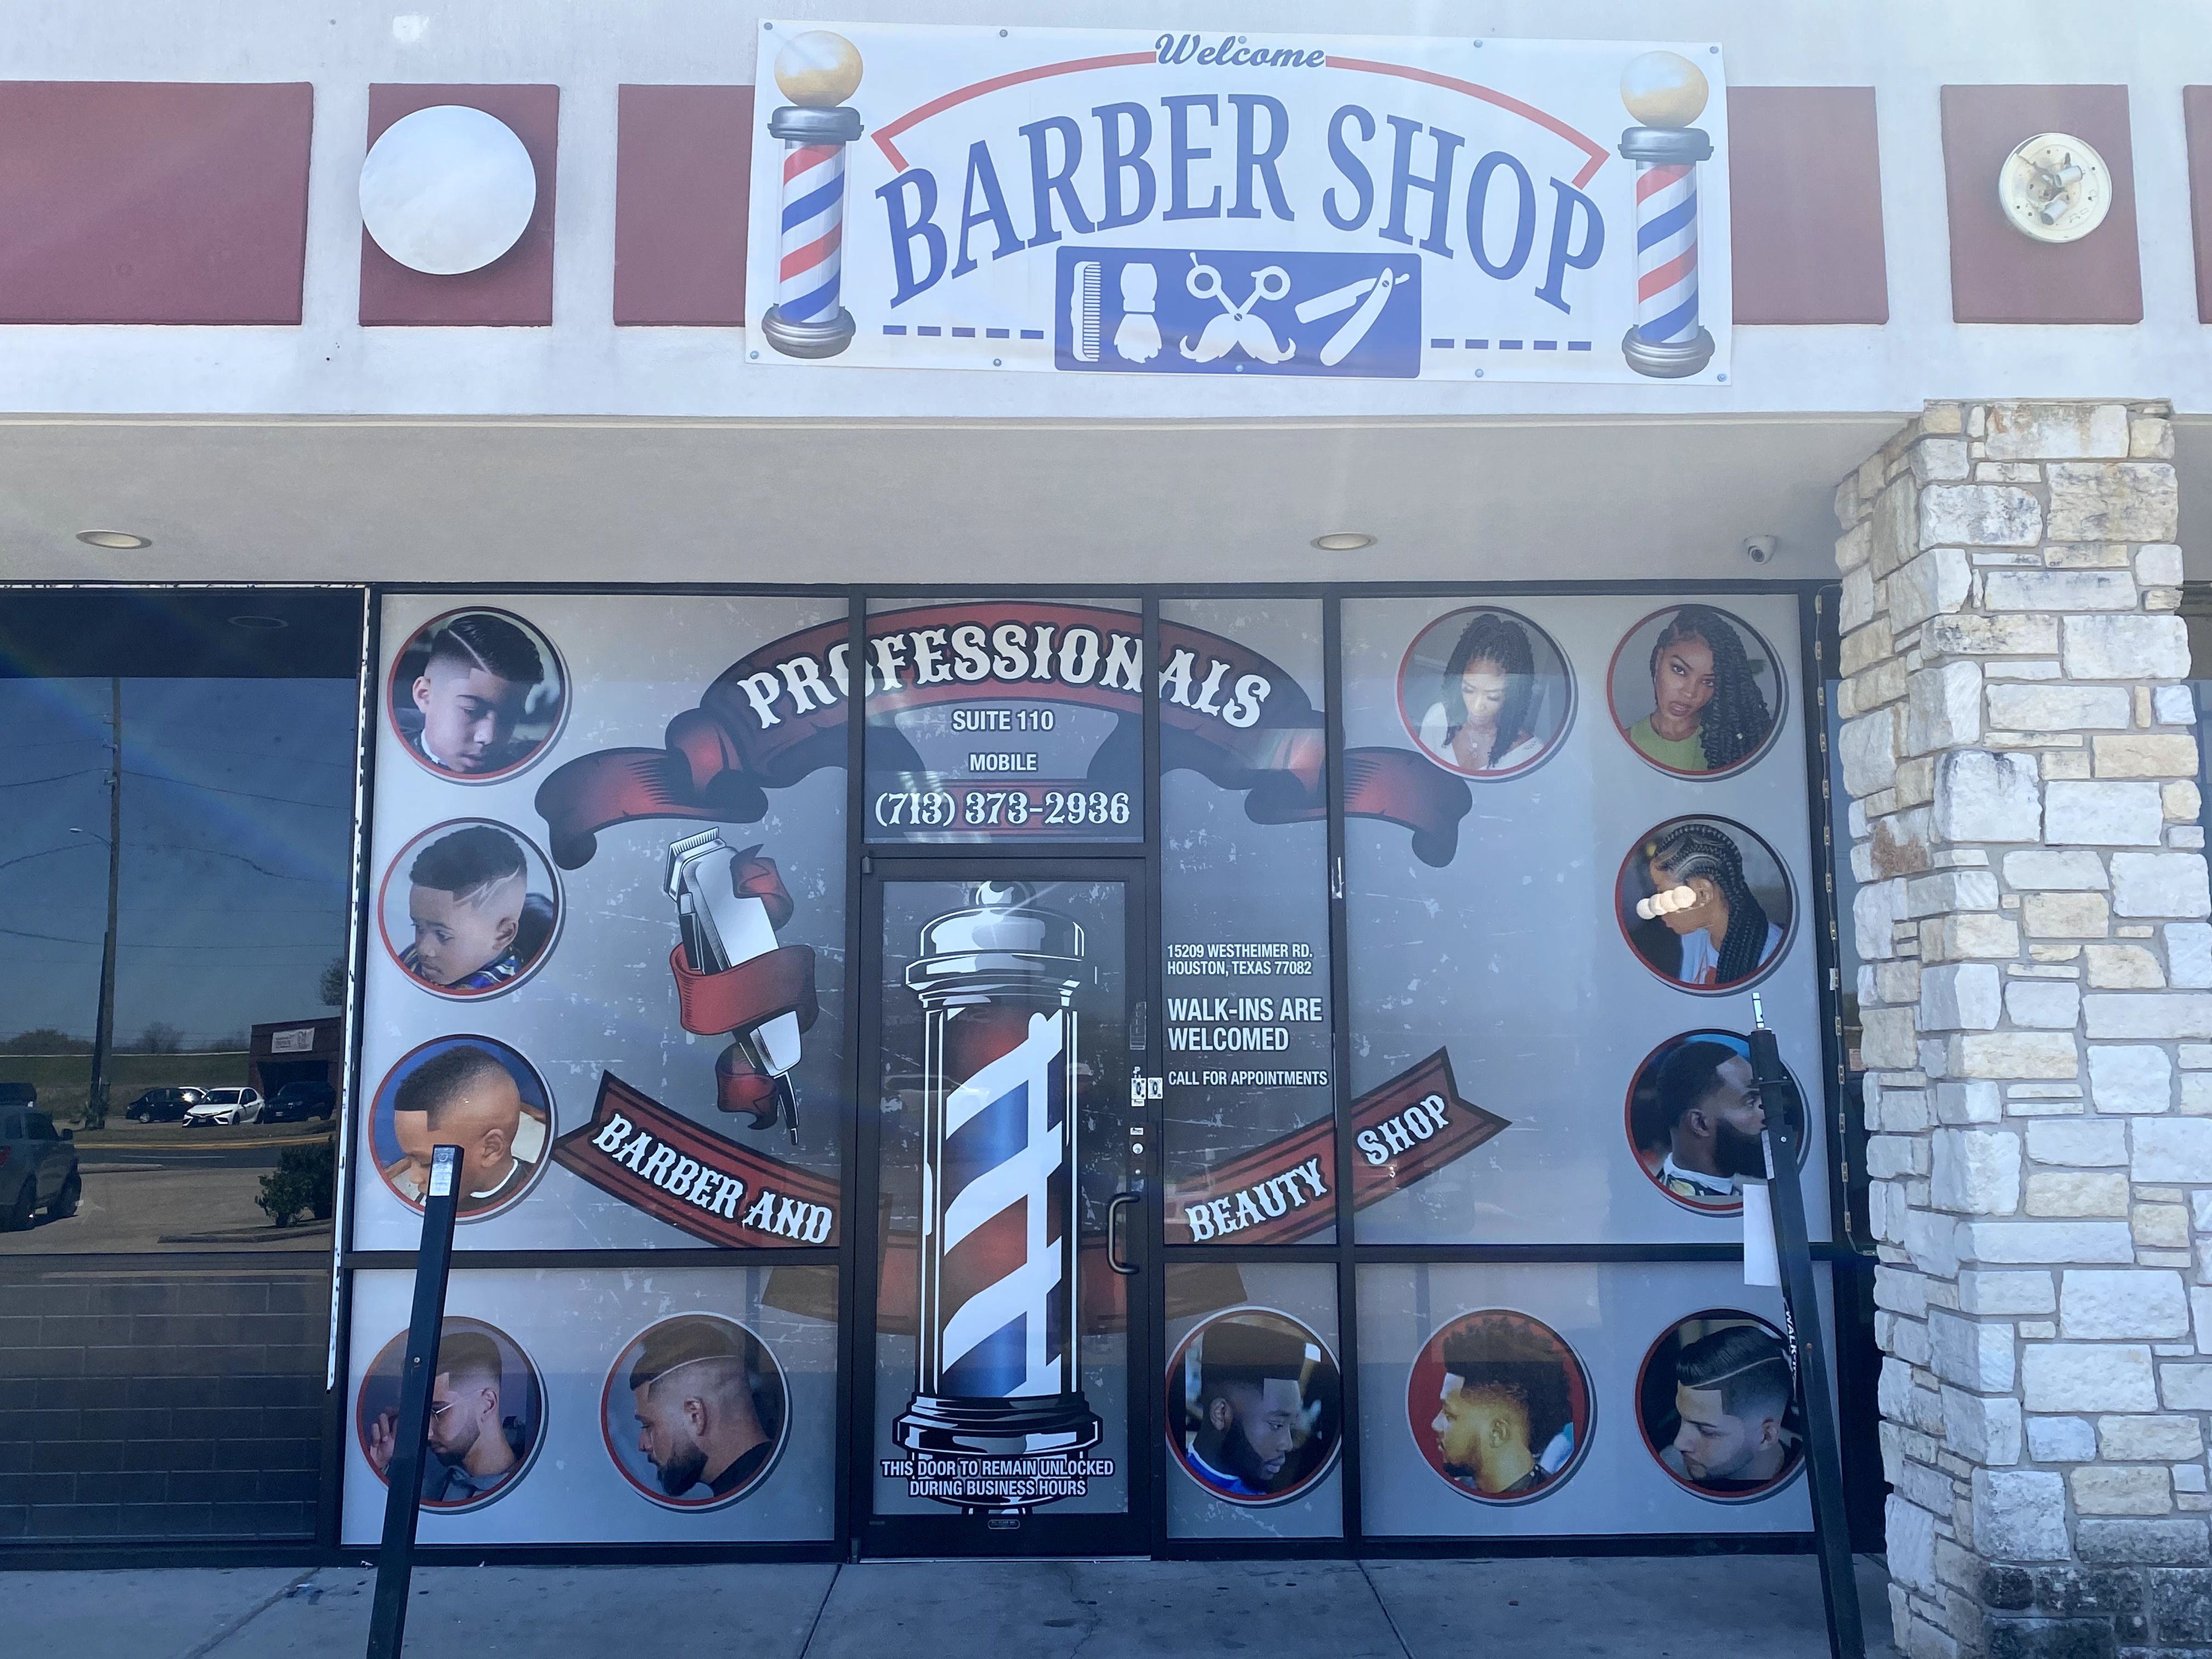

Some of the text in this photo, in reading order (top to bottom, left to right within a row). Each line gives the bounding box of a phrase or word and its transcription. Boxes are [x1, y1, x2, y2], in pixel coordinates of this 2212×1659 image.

[1155, 33, 1325, 67] Welcome
[875, 94, 1605, 315] BARBER SHOP
[736, 625, 1271, 730] PROFESSIONALS
[953, 710, 1054, 730] SUITE 110
[969, 754, 1037, 771] MOBILE
[875, 792, 1130, 827] (713) 373-2936
[1167, 944, 1313, 958] 15209 WESTHEIMER RD.
[1167, 961, 1312, 977] HOUSTON, TEXAS 77082
[1167, 998, 1323, 1021] WALK-INS ARE
[1167, 1028, 1289, 1051] WELCOMED
[1168, 1071, 1328, 1085] CALL FOR APPOINTMENTS
[592, 1113, 833, 1244] BARBER AND
[1184, 1095, 1449, 1242] BEAUTY SHOP
[882, 1460, 1113, 1476] THIS DOOR TO REMAIN UNLOCKED
[910, 1480, 1086, 1496] DURING BUSINESS HOURS
